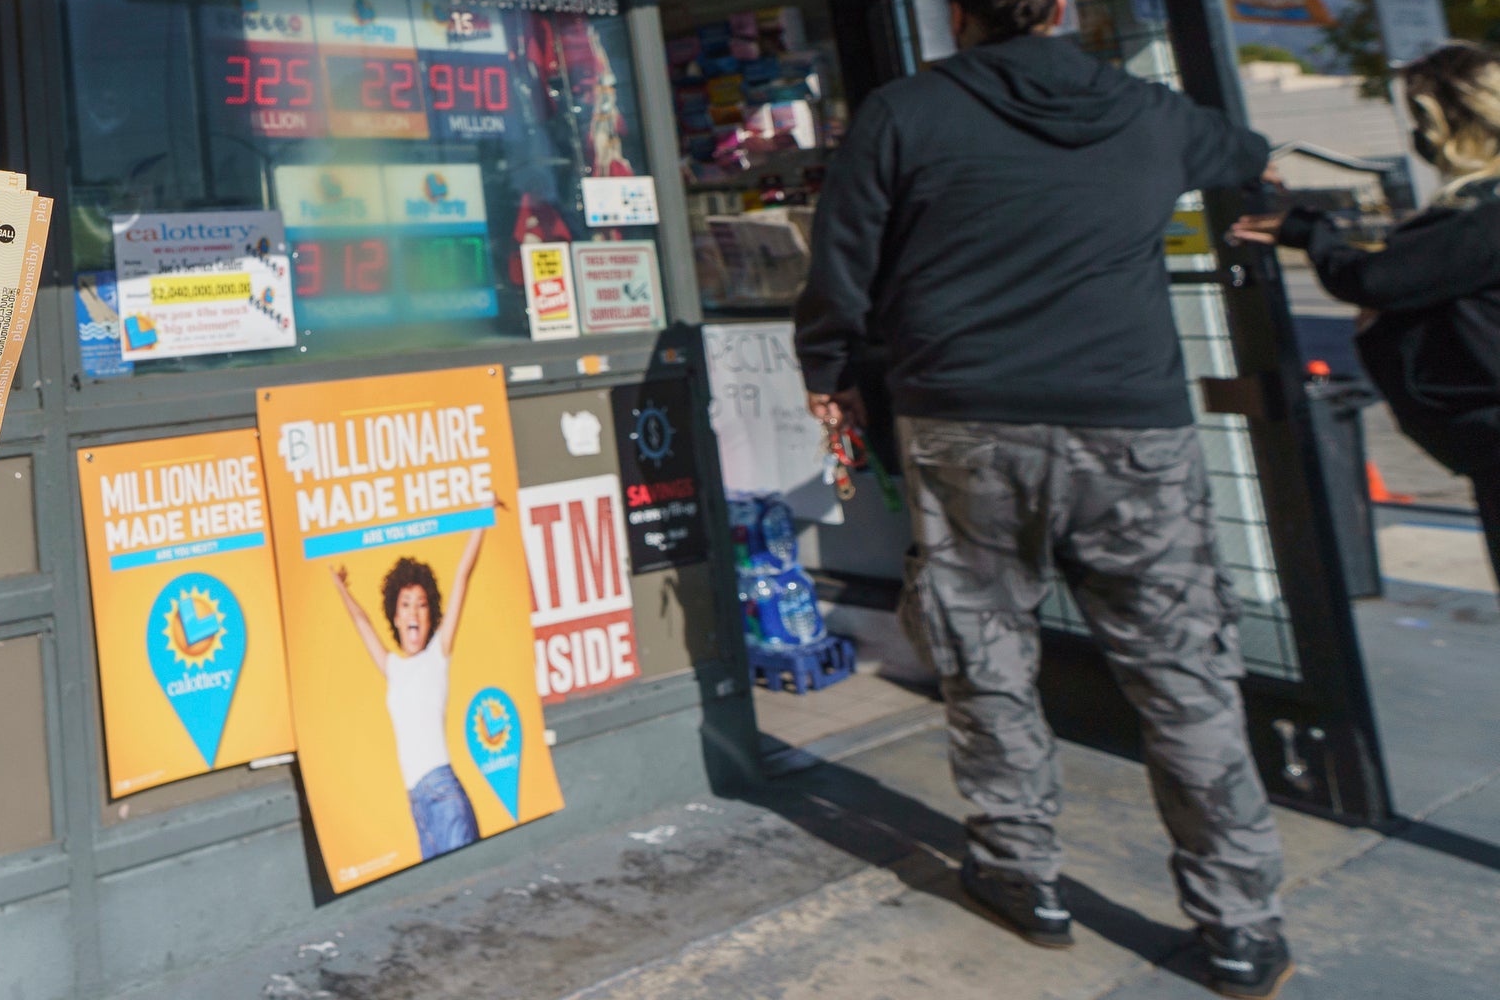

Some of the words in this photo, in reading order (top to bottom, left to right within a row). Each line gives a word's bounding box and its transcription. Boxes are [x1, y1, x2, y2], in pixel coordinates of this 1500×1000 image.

[225, 56, 313, 106] 325
[362, 62, 414, 109] 22
[429, 64, 508, 111] 940
[448, 115, 505, 133] MILLION
[125, 223, 252, 243] calottery
[19, 241, 46, 308] responsibly
[0, 300, 14, 309] 24
[12, 310, 27, 342] play
[288, 428, 309, 462] B
[99, 456, 260, 517] MILLIONAIRE
[296, 476, 398, 532] MADE
[403, 463, 495, 514] HERE
[105, 510, 185, 552] MADE
[190, 499, 265, 537] HERE
[362, 531, 384, 545] ARE
[386, 527, 406, 541] YOU
[156, 549, 173, 561] ARE
[174, 547, 190, 557] YOU
[527, 496, 623, 613] TM
[167, 669, 233, 697] calottery
